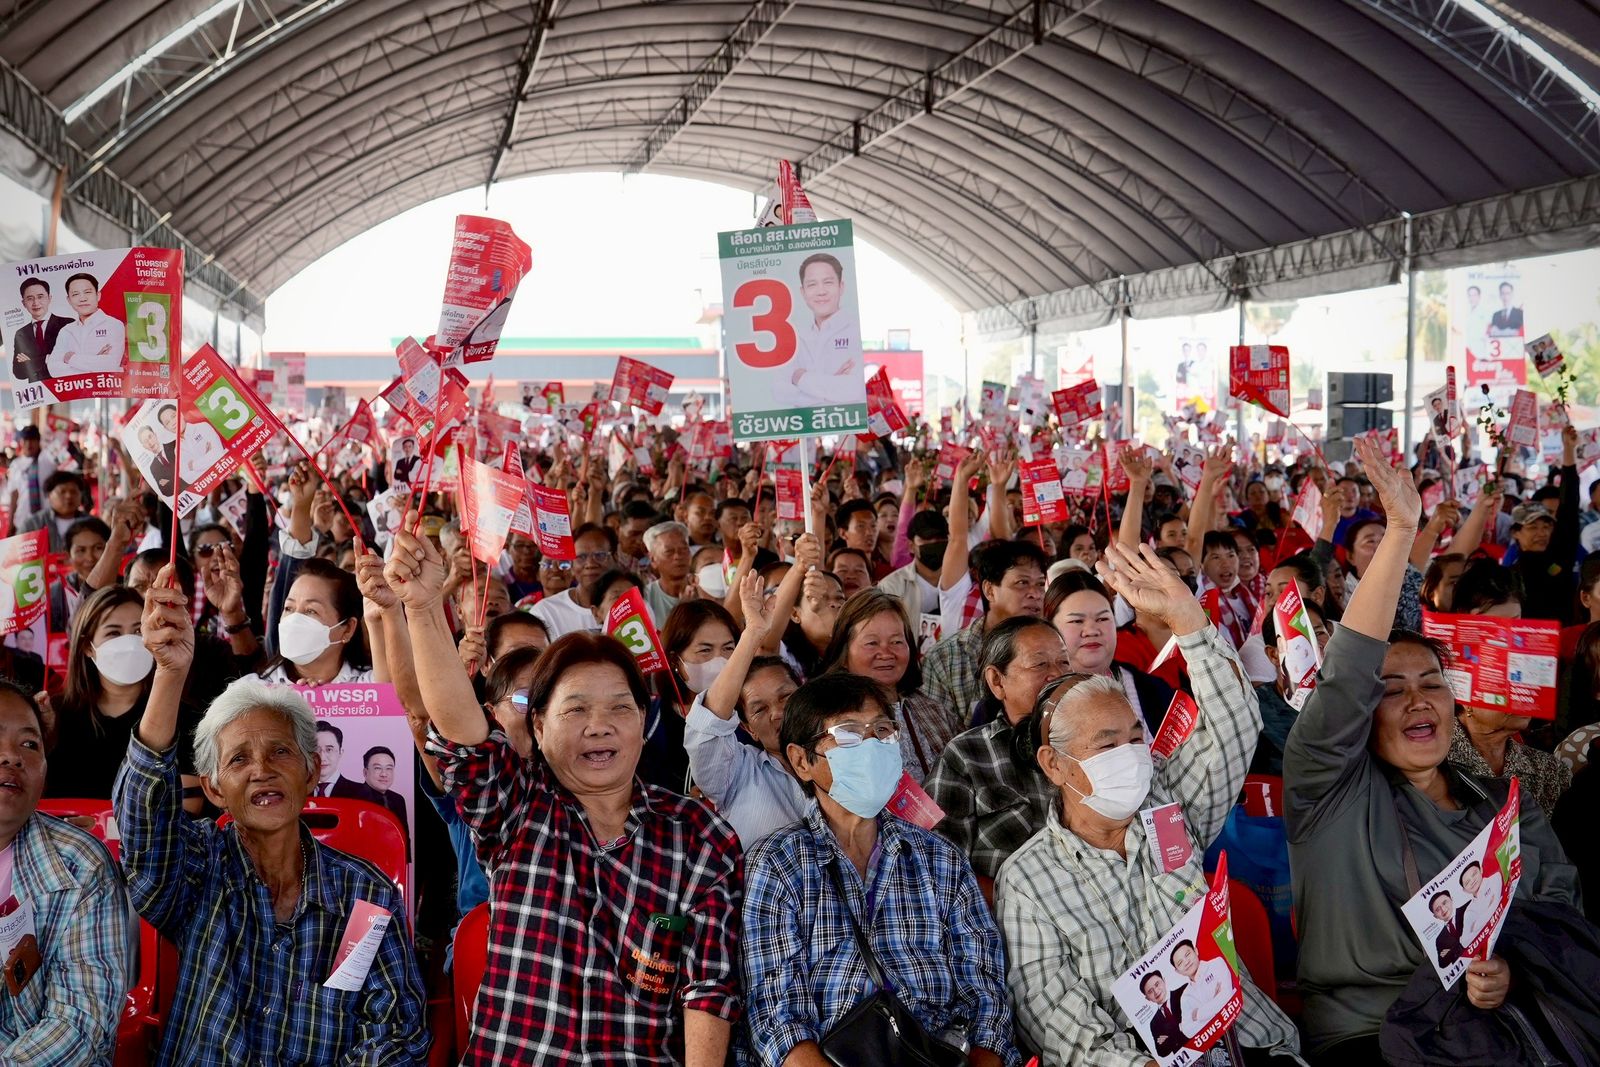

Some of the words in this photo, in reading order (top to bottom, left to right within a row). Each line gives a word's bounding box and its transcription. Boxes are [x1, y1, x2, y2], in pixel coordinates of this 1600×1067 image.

[730, 231, 762, 246] เลือก
[766, 224, 839, 242] สส.เขตสอง
[16, 263, 40, 277] พท
[41, 258, 94, 273] พรรคเพื่อไทย
[135, 259, 169, 268] เกษตรกร
[136, 267, 167, 278] ไทยไร้จน
[736, 257, 782, 270] บัตรสีเขียว
[137, 301, 167, 360] 3
[733, 278, 797, 368] 3
[1489, 339, 1501, 358] 3
[16, 385, 44, 405] พท
[54, 377, 93, 393] ชัยพร
[97, 374, 122, 389] สีถัน
[131, 381, 170, 394] เพื่อไทยทำได้
[209, 386, 250, 430] 3
[738, 415, 803, 435] ชัยพร
[812, 407, 860, 429] สีถัน
[241, 423, 272, 457] เพื่อไทยทำได้
[194, 473, 218, 493] ชัยพร
[214, 456, 235, 473] สีถัน
[18, 565, 45, 602] 3
[621, 620, 652, 654] 3
[322, 689, 378, 703] พรรค
[312, 702, 373, 717] บัญชีรายชื่อ
[1439, 850, 1475, 886] พรรคเพื่อไทย
[1149, 927, 1185, 965] พรรคเพื่อไทย
[1194, 1019, 1222, 1048] ชัยพร
[1220, 997, 1240, 1021] สีถัน
